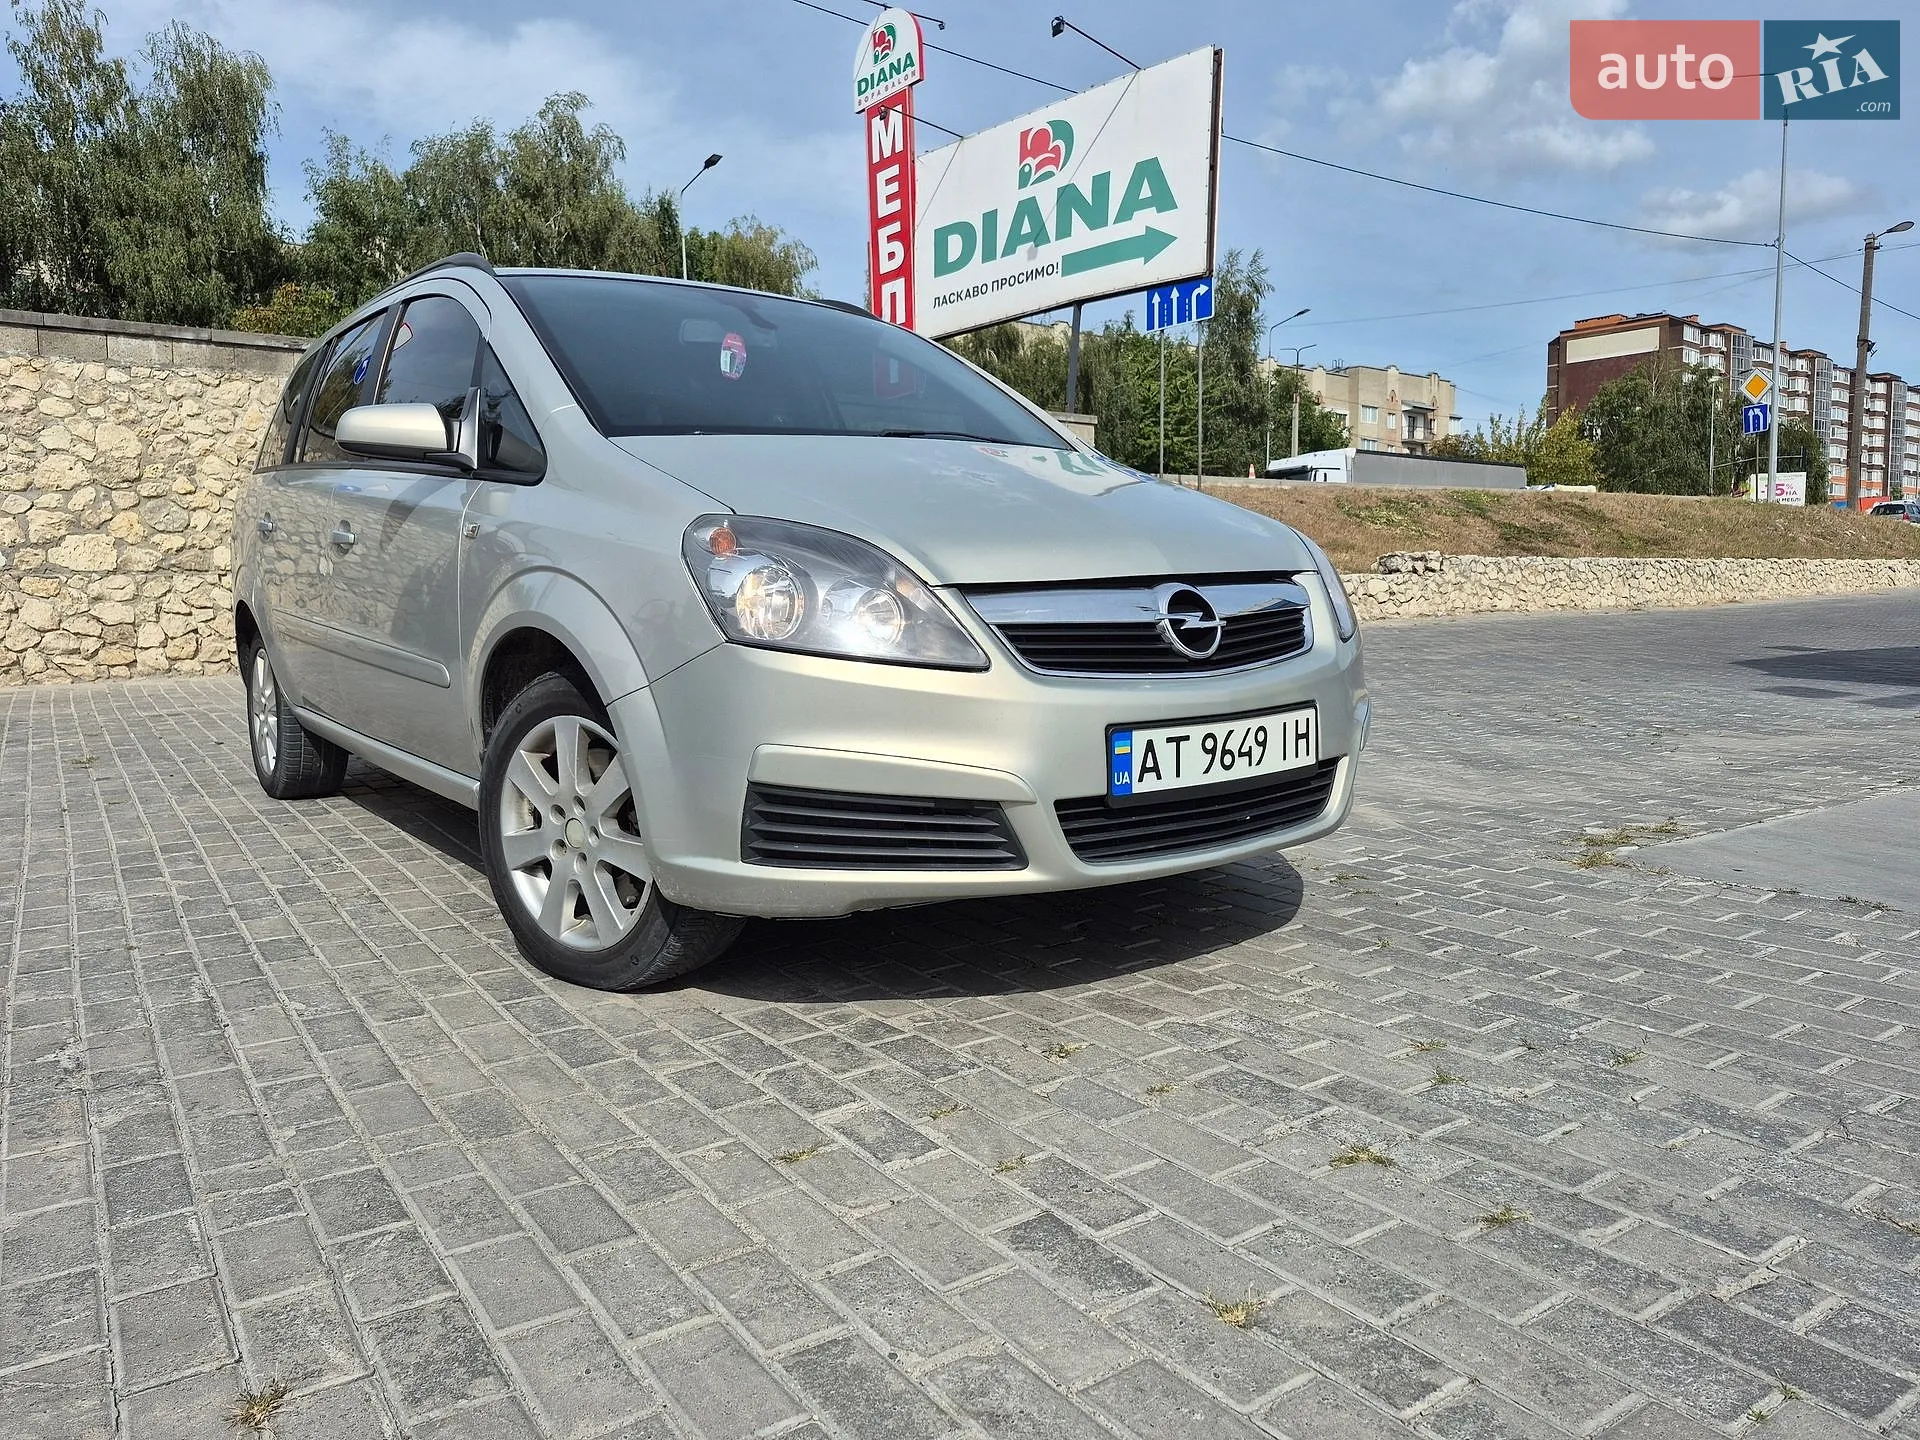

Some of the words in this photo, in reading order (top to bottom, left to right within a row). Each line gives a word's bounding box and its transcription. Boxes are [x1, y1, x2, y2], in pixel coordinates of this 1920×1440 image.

[857, 51, 915, 97] DIANA
[934, 156, 1178, 278] DIANA
[933, 283, 988, 309] ЛАСКАВО
[991, 262, 1060, 292] ПРОСИМО!
[1114, 771, 1130, 785] UA
[1138, 735, 1190, 783] AT
[1201, 725, 1268, 775] 9649
[1282, 717, 1310, 761] IH
